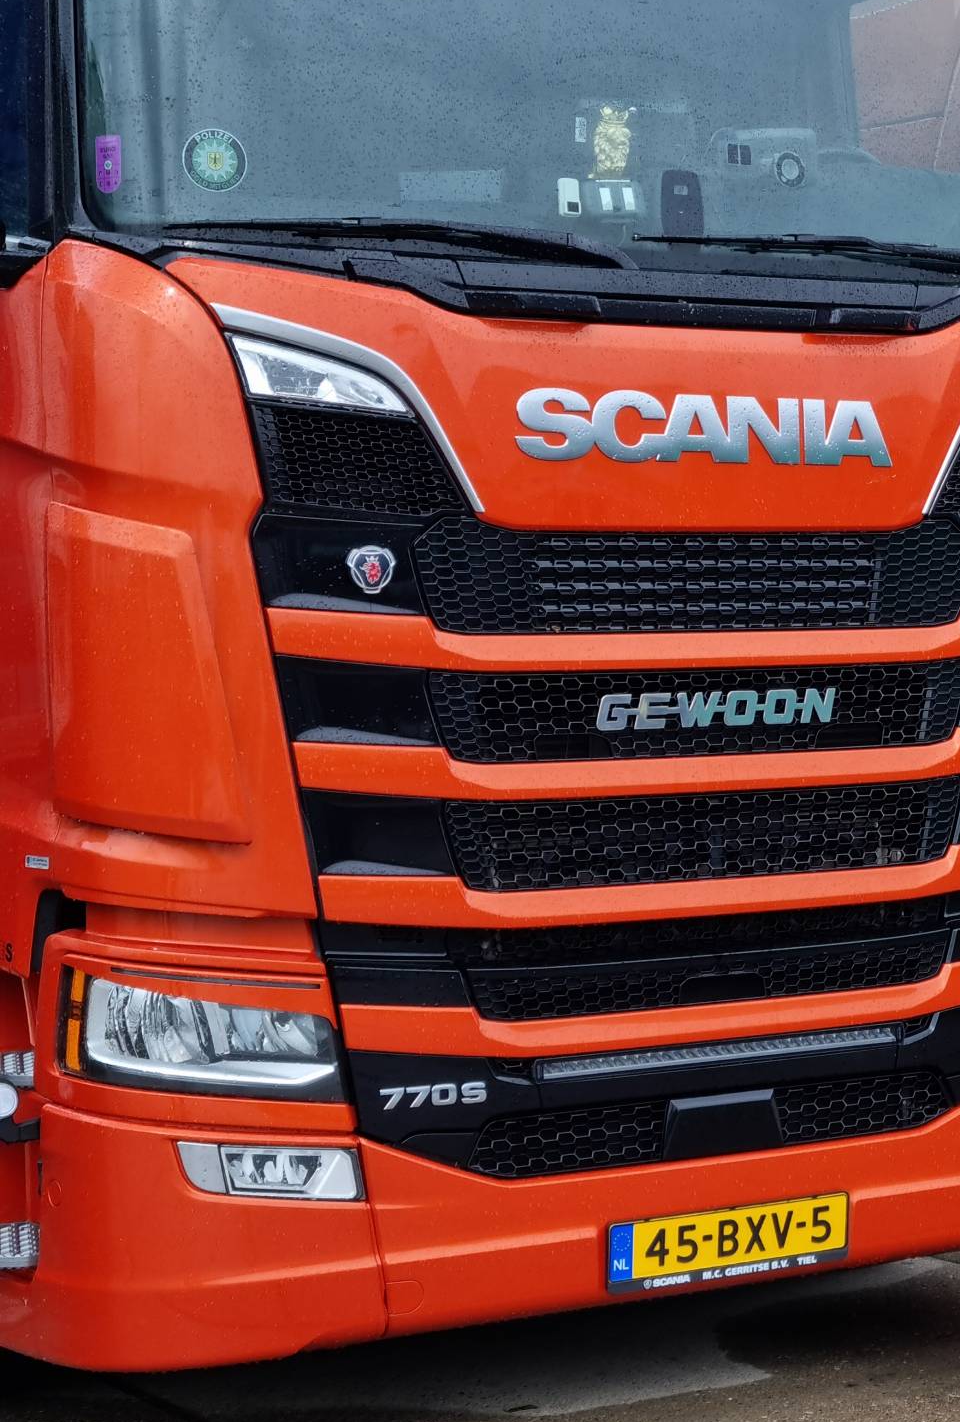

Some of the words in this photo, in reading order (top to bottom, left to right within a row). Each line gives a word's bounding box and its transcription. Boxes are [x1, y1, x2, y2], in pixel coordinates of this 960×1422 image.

[194, 130, 233, 144] POLIZEI
[514, 387, 894, 467] SCANIA
[596, 687, 836, 731] GEWOON
[613, 1257, 629, 1271] NL
[645, 1205, 832, 1267] 45-BXV-5
[652, 1274, 691, 1288] SCANIA
[702, 1270, 723, 1280] M.C.
[725, 1261, 769, 1277] GERRITSE
[771, 1259, 789, 1270] B.V.
[797, 1255, 817, 1266] TIEL
